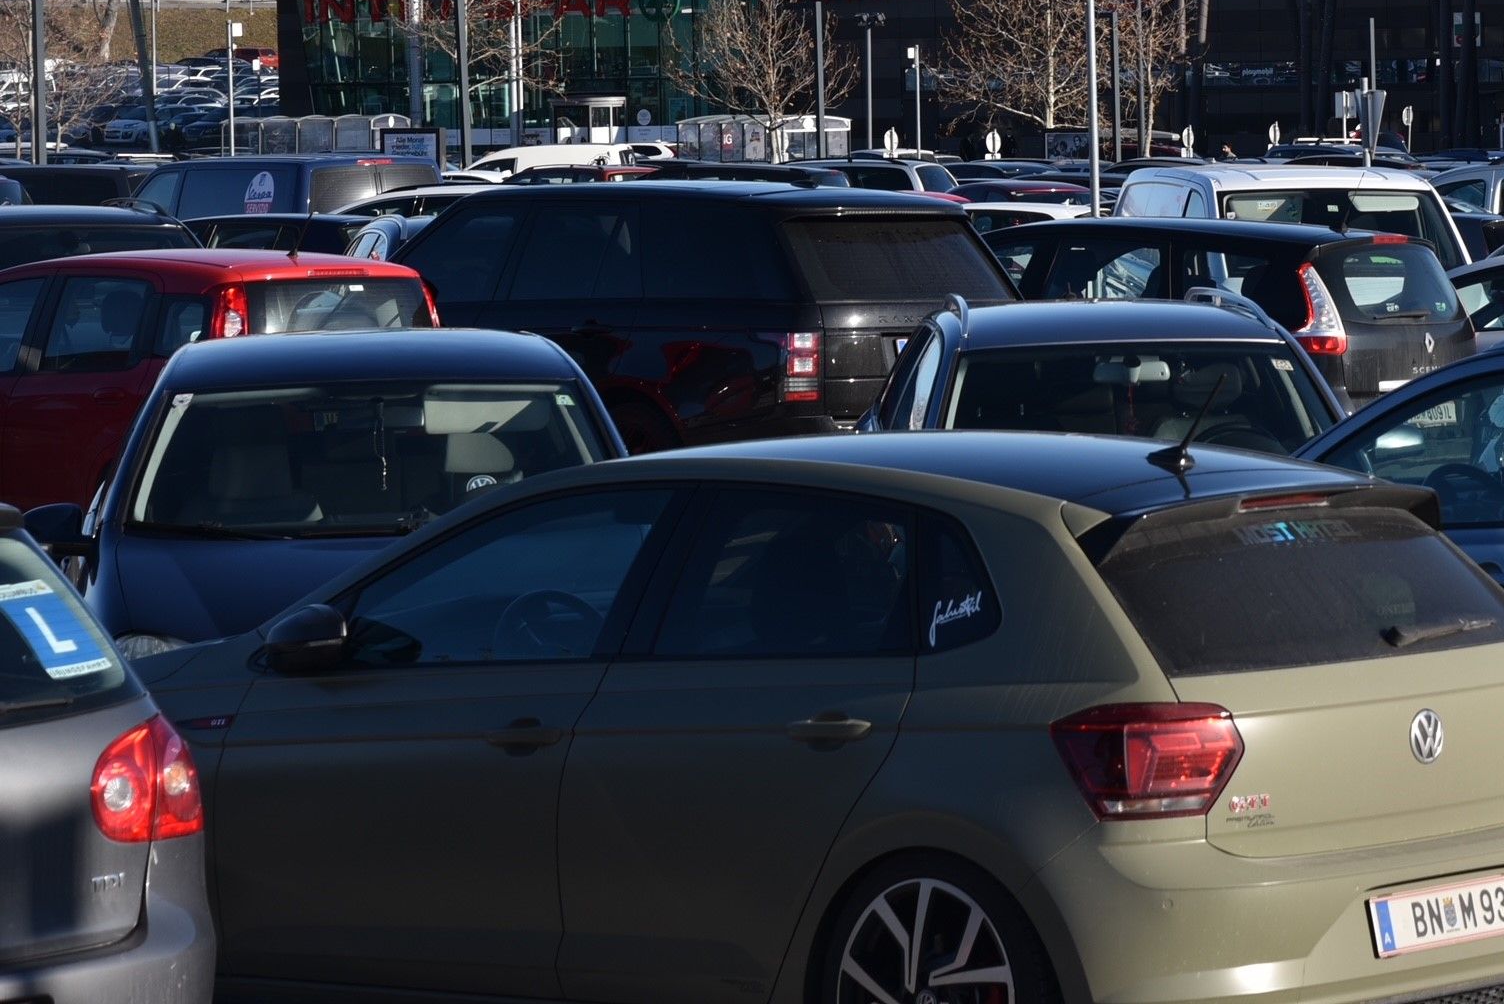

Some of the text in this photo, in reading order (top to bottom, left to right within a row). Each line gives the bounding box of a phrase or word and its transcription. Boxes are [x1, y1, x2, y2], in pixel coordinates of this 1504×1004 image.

[1242, 67, 1274, 78] playmobil
[247, 182, 272, 201] Vespa
[1231, 522, 1295, 546] MOST
[24, 606, 78, 654] L
[1229, 793, 1270, 813] GTI
[91, 872, 125, 893] TDI
[1411, 897, 1445, 938] BN
